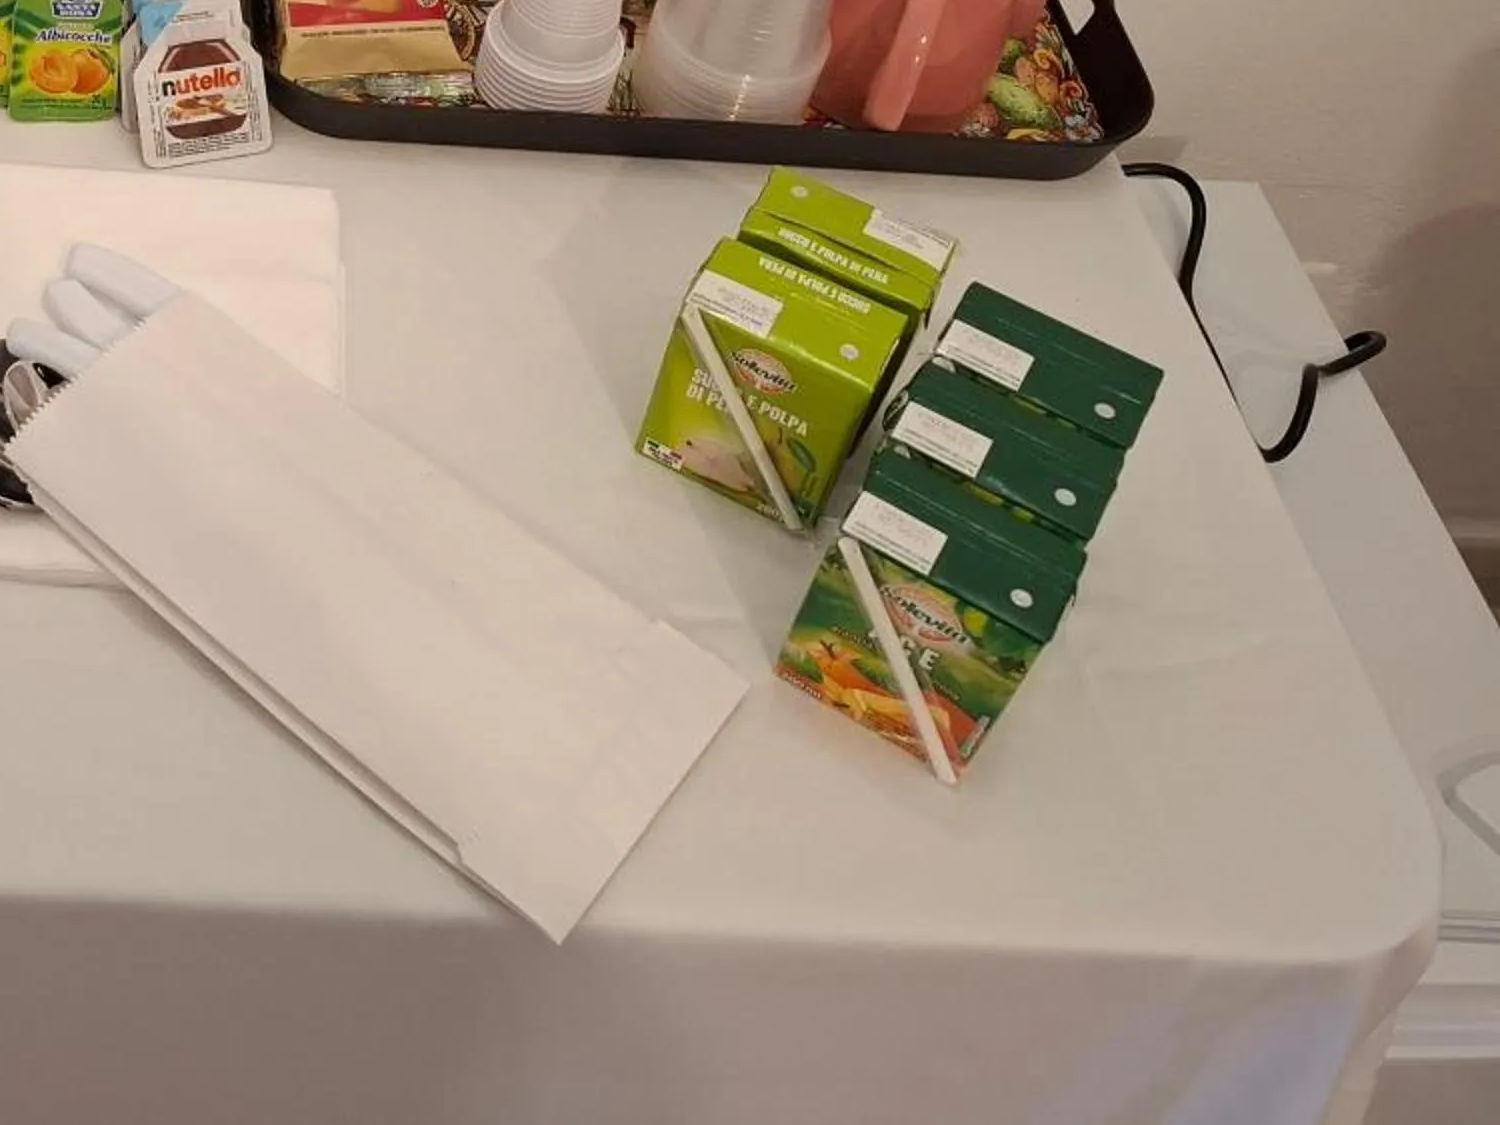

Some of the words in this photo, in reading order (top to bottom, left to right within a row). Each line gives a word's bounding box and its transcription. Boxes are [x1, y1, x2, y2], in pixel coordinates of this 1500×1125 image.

[162, 66, 241, 97] nutella
[686, 382, 705, 402] DI
[758, 400, 809, 437] POLPA
